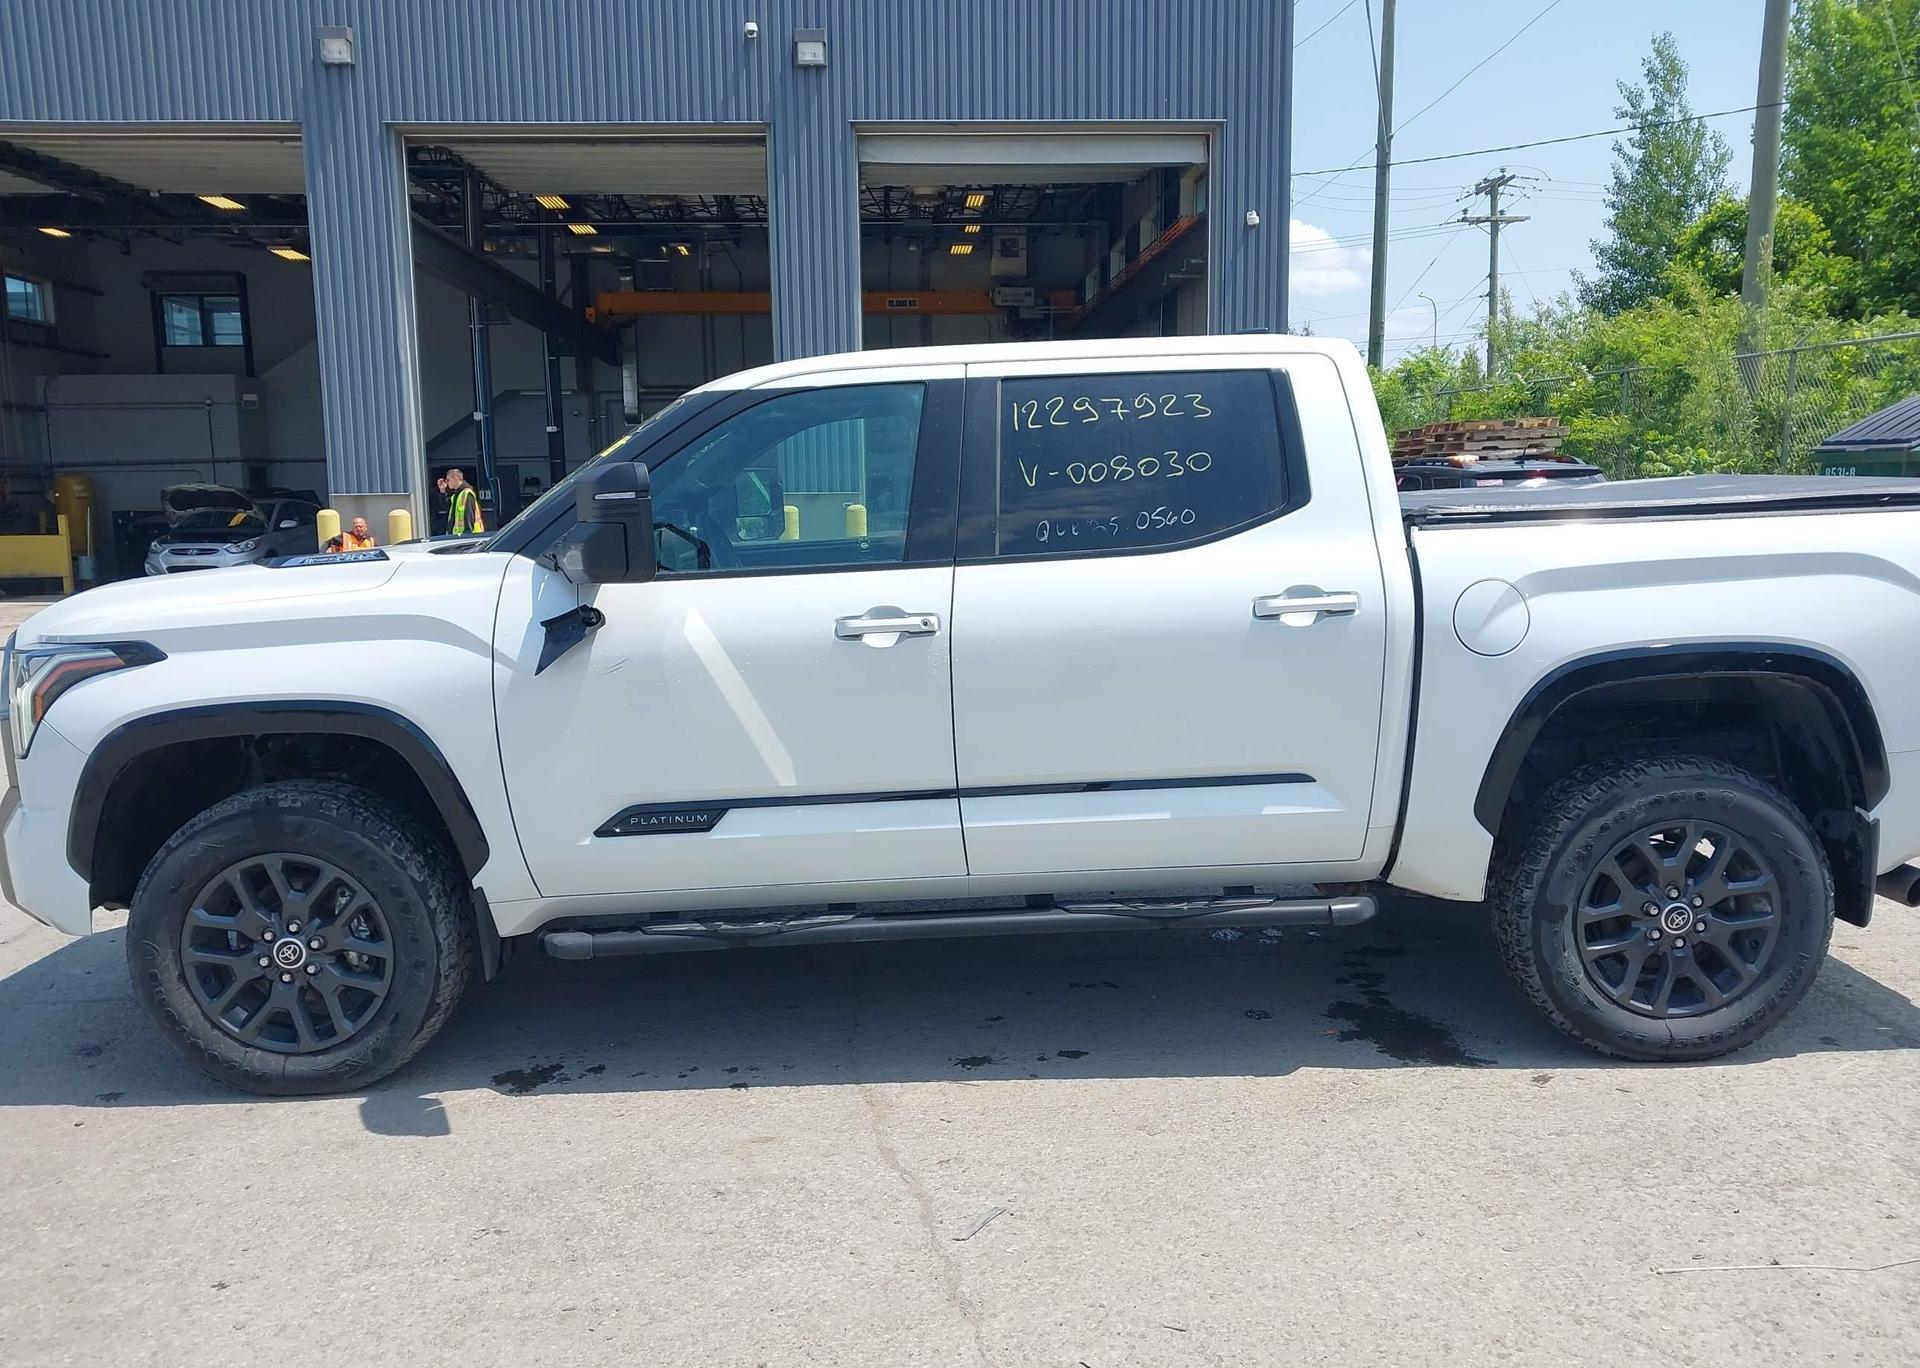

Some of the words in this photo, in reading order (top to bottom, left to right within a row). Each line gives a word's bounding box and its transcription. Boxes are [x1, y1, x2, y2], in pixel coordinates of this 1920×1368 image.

[1012, 392, 1212, 431] 12297923
[1018, 450, 1212, 488] V-008030
[630, 814, 708, 825] PLATINUM
